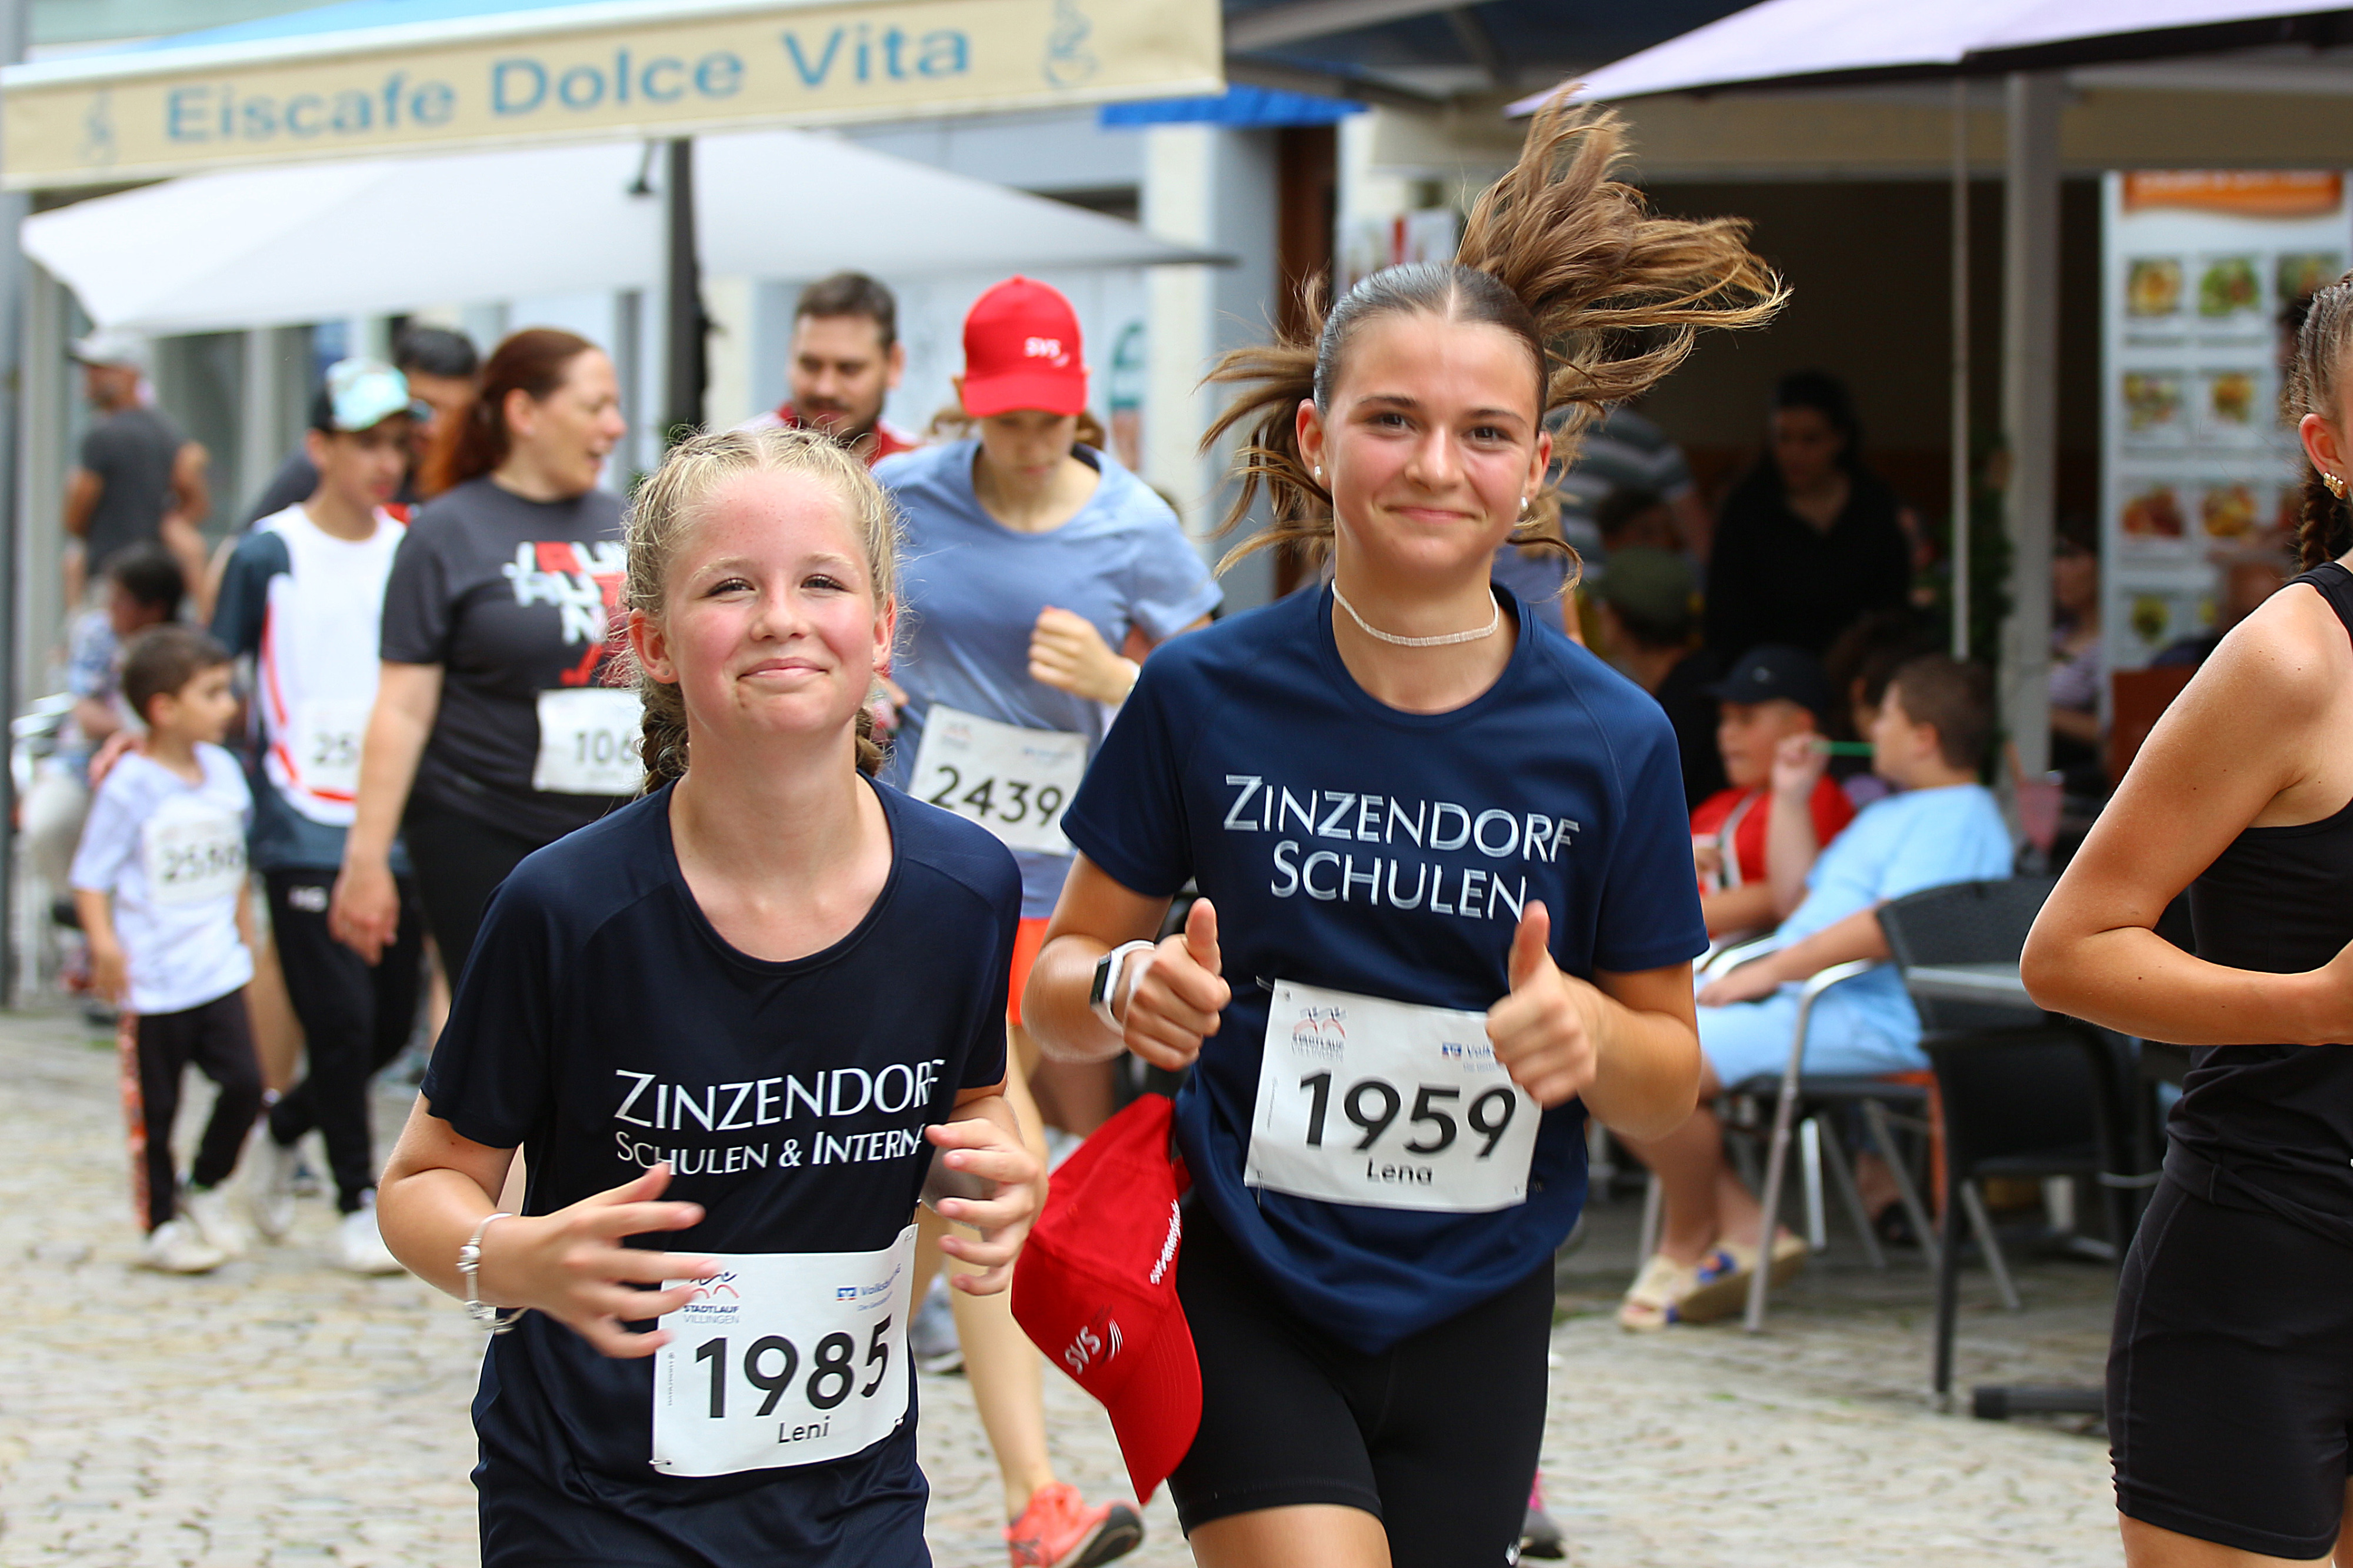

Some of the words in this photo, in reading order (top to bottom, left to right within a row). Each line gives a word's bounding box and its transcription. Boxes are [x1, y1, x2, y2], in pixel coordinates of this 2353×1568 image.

[165, 69, 457, 144] Eiscafe
[489, 47, 745, 117] Dolce
[781, 25, 972, 86] Vita
[929, 765, 1063, 826] 2439
[1224, 773, 1579, 863] ZINZENDORF
[1271, 840, 1528, 924] SCHULEN
[614, 1059, 946, 1132] ZINZENDORF
[1299, 1070, 1517, 1159] 1959
[615, 1131, 769, 1176] SCHULEN
[778, 1139, 804, 1168] &
[1367, 1157, 1434, 1186] Lena
[684, 1305, 739, 1313] STADTLAUF
[684, 1314, 740, 1324] VILLINGEN
[695, 1313, 892, 1419] 1985
[1065, 1325, 1101, 1375] SVS
[777, 1415, 831, 1444] Leni
